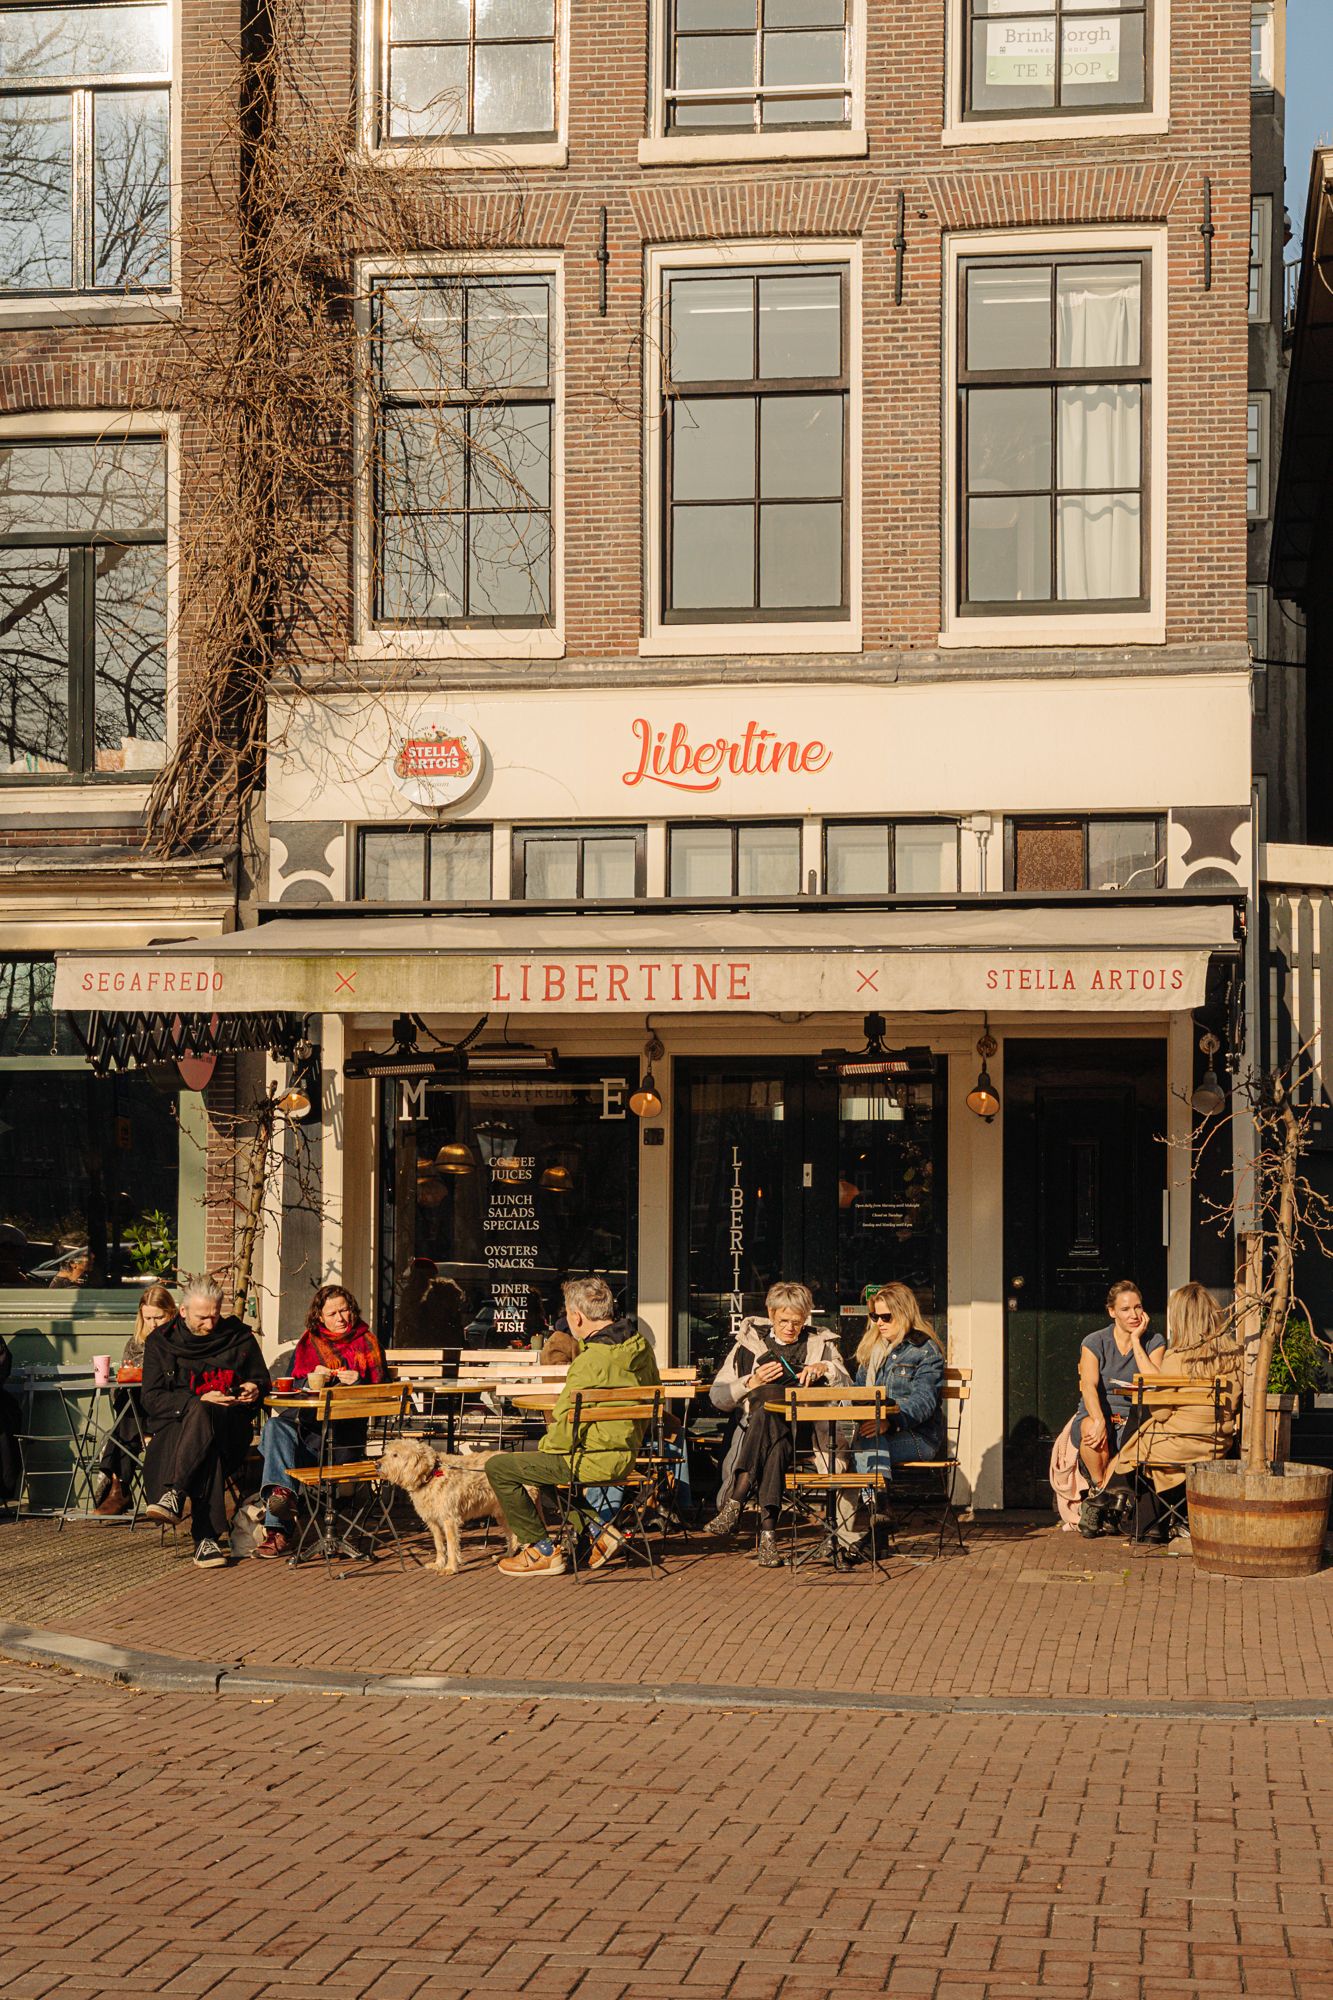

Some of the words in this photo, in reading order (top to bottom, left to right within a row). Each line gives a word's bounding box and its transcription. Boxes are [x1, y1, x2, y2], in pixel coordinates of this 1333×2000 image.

[1013, 63, 1038, 78] TE
[1045, 61, 1102, 77] KOOP
[408, 746, 460, 758] STELLA
[622, 718, 834, 794] Libertine
[408, 758, 460, 769] ARTOIS
[81, 971, 224, 992] SEGAFREDO
[492, 963, 751, 1001] LIBERTINE
[986, 969, 1076, 990] STELLA
[1090, 969, 1184, 990] ARTOIS
[399, 1079, 429, 1121] M
[600, 1078, 626, 1119] E
[489, 1156, 536, 1167] COFFEE
[491, 1169, 532, 1182] JUICES
[490, 1195, 533, 1205] LUNCH
[488, 1207, 535, 1218] SALADS
[483, 1220, 540, 1231] SPECIALS
[729, 1146, 744, 1335] LIBERTINE
[484, 1245, 538, 1256] OYSTERS
[487, 1258, 535, 1269] SNACKS
[491, 1284, 531, 1294] DINER
[494, 1296, 528, 1307] WINE
[493, 1309, 528, 1320] MEAT
[496, 1322, 525, 1333] FISH
